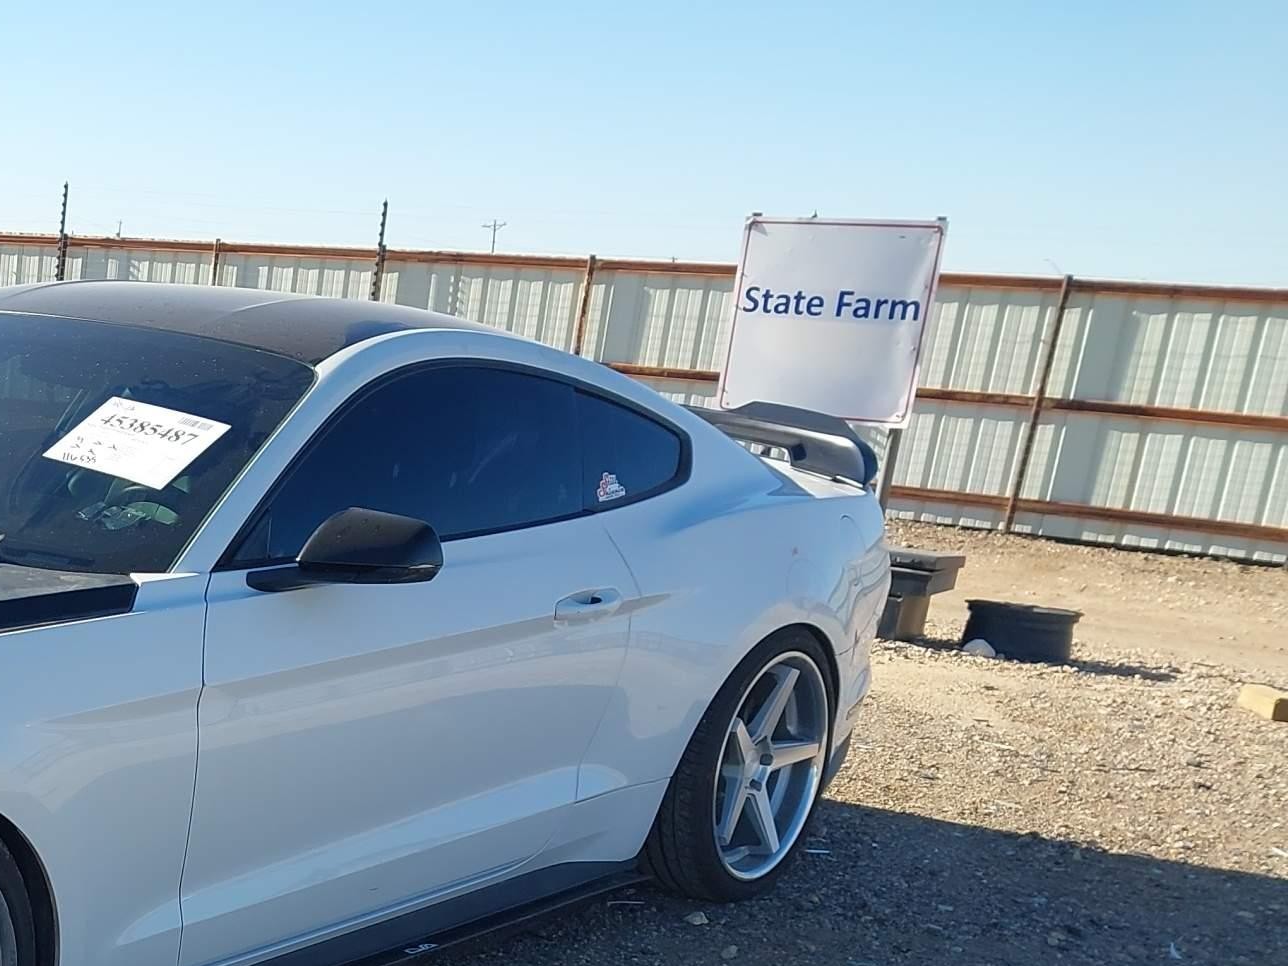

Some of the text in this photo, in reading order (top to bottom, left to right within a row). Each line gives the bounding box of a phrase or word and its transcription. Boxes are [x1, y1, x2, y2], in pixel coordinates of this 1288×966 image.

[743, 286, 921, 322] State Farm
[100, 413, 200, 446] 45385487
